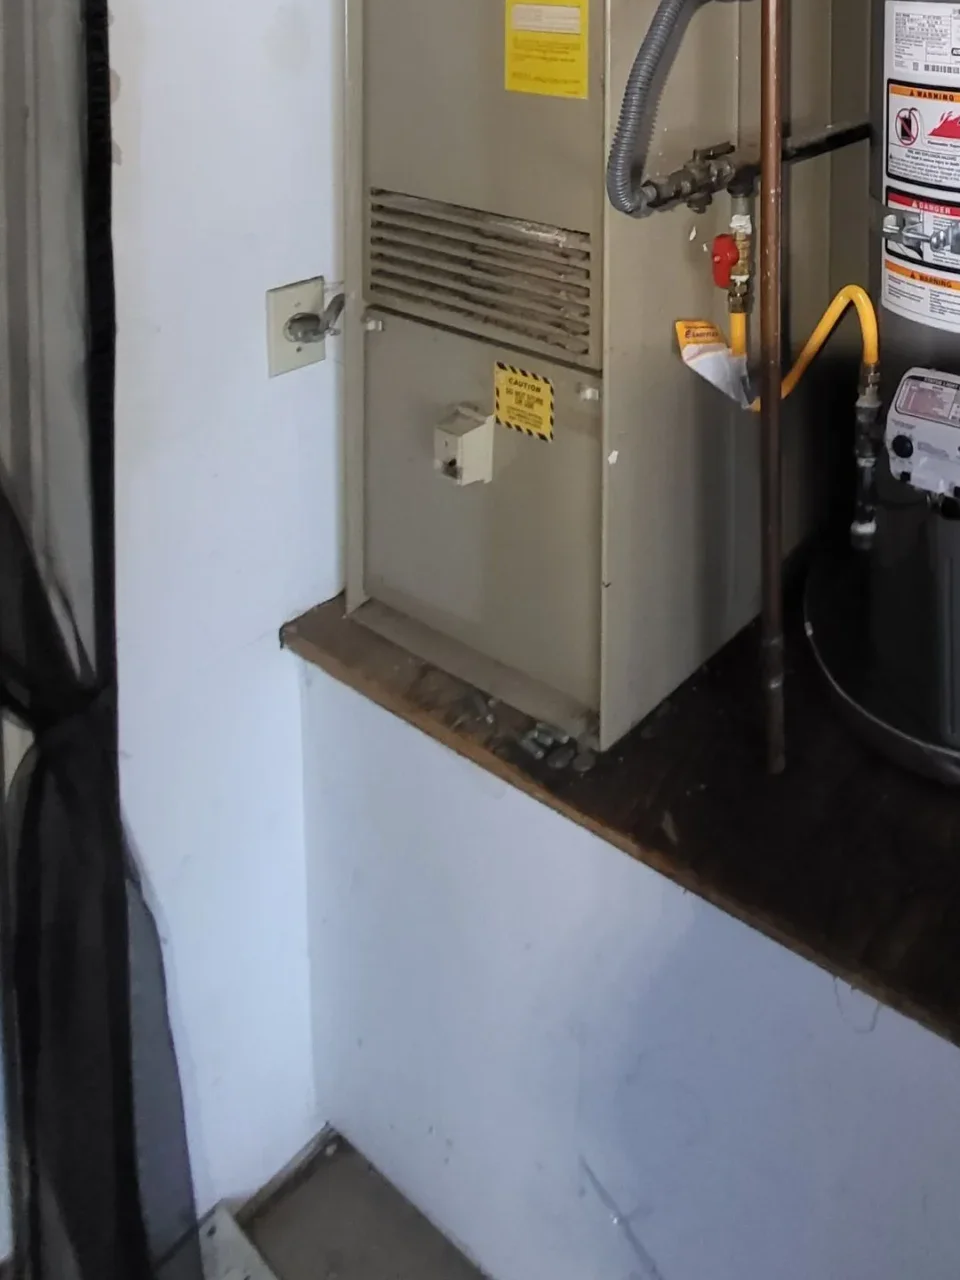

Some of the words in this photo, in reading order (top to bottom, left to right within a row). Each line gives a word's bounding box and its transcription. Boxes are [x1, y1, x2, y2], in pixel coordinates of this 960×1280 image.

[917, 92, 955, 102] WARNING
[919, 201, 951, 215] DANGER
[919, 274, 953, 288] WARNING
[508, 377, 541, 392] CAUTION
